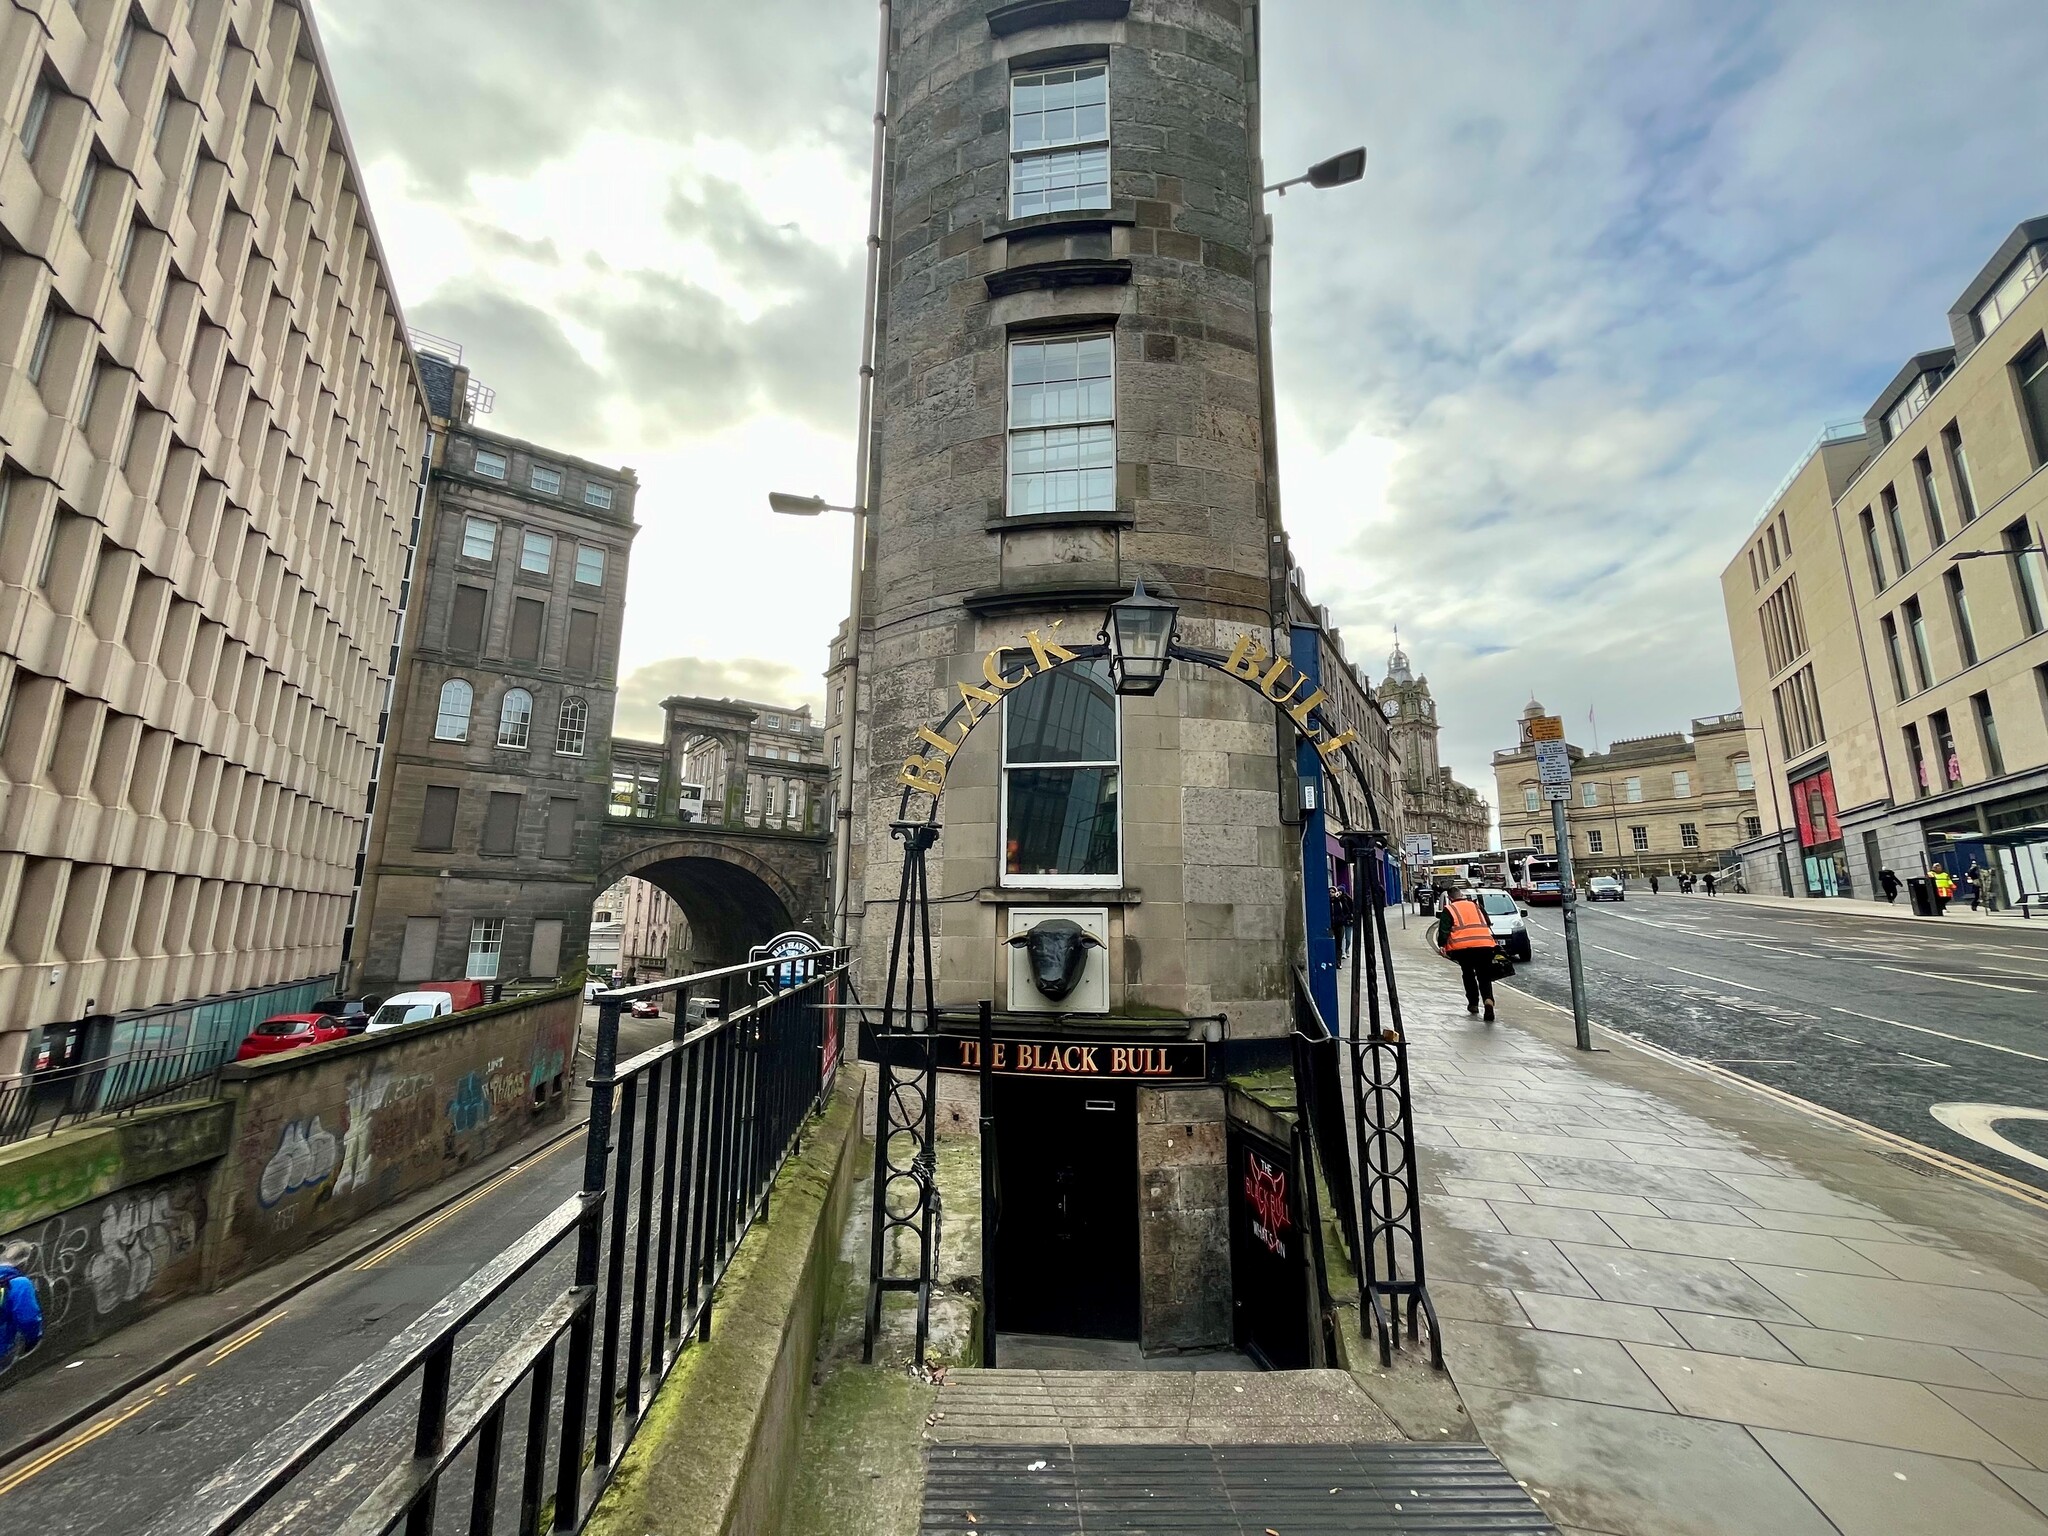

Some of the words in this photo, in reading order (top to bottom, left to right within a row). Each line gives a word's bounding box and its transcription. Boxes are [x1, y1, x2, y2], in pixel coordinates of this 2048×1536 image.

[898, 619, 1081, 801] BLACK
[1219, 632, 1359, 774] BULL
[1016, 1044, 1099, 1073] BLACK
[1110, 1047, 1174, 1075] BULL
[1261, 1159, 1272, 1177] THE
[1246, 1177, 1269, 1207] BLACK
[1271, 1194, 1291, 1225] BULL
[1276, 1239, 1286, 1259] ON
